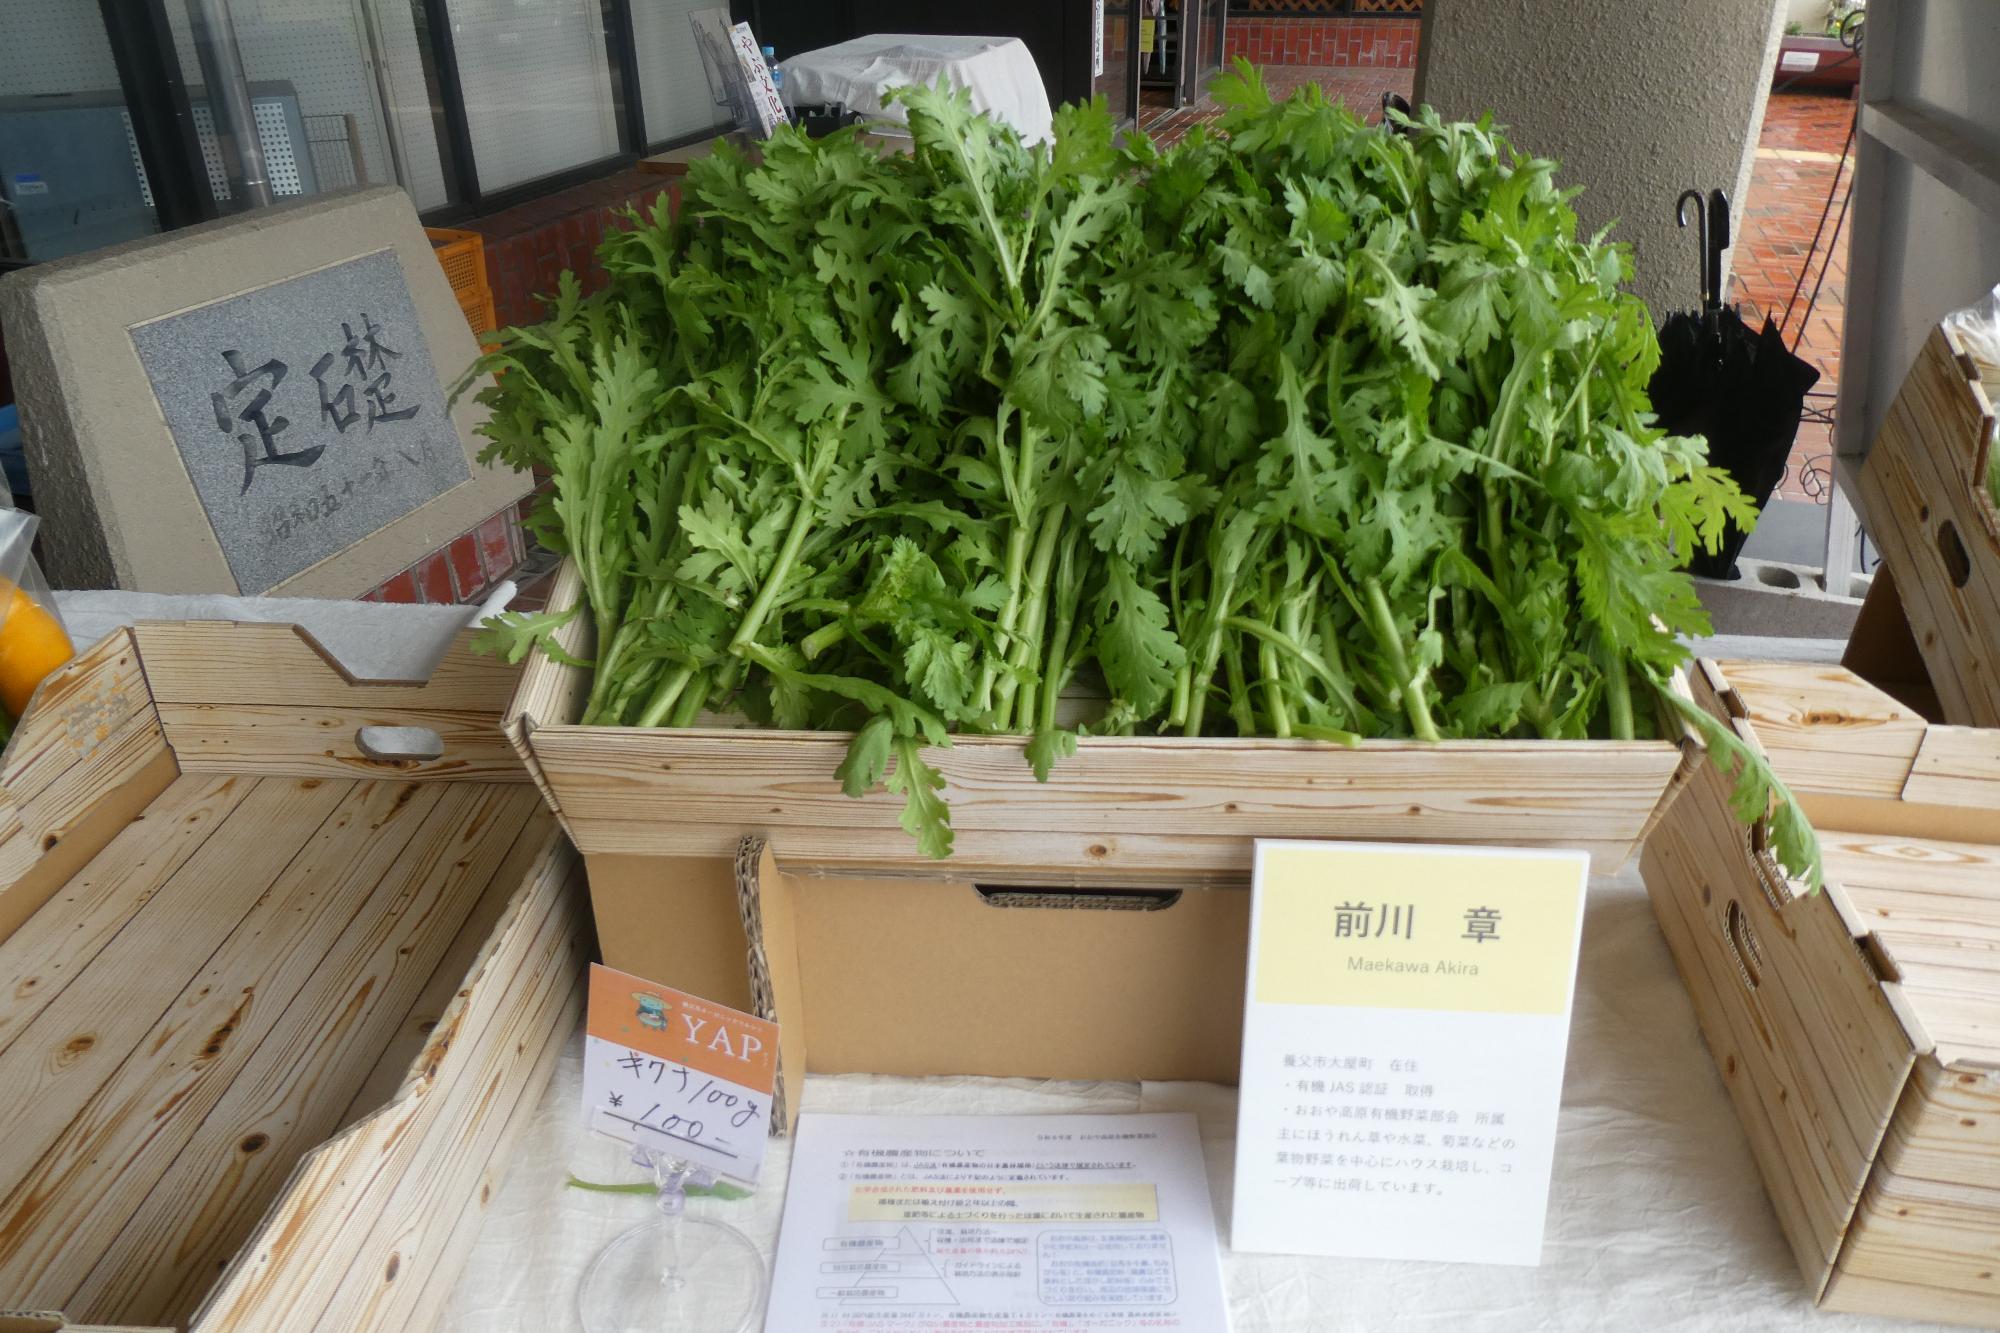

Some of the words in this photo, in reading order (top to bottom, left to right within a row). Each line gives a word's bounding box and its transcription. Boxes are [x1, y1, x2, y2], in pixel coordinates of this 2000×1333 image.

[211, 313, 421, 497] 定礎
[1334, 901, 1414, 940] 前川
[1461, 906, 1502, 943] 章
[1347, 956, 1430, 974] Maekawa
[1434, 960, 1479, 976] Akira
[681, 1012, 762, 1062] YAP
[1283, 1054, 1372, 1070] 養父市大屋町
[1390, 1058, 1418, 1072] 在住
[1405, 1083, 1434, 1098] 取得
[1475, 1111, 1505, 1126] 所属
